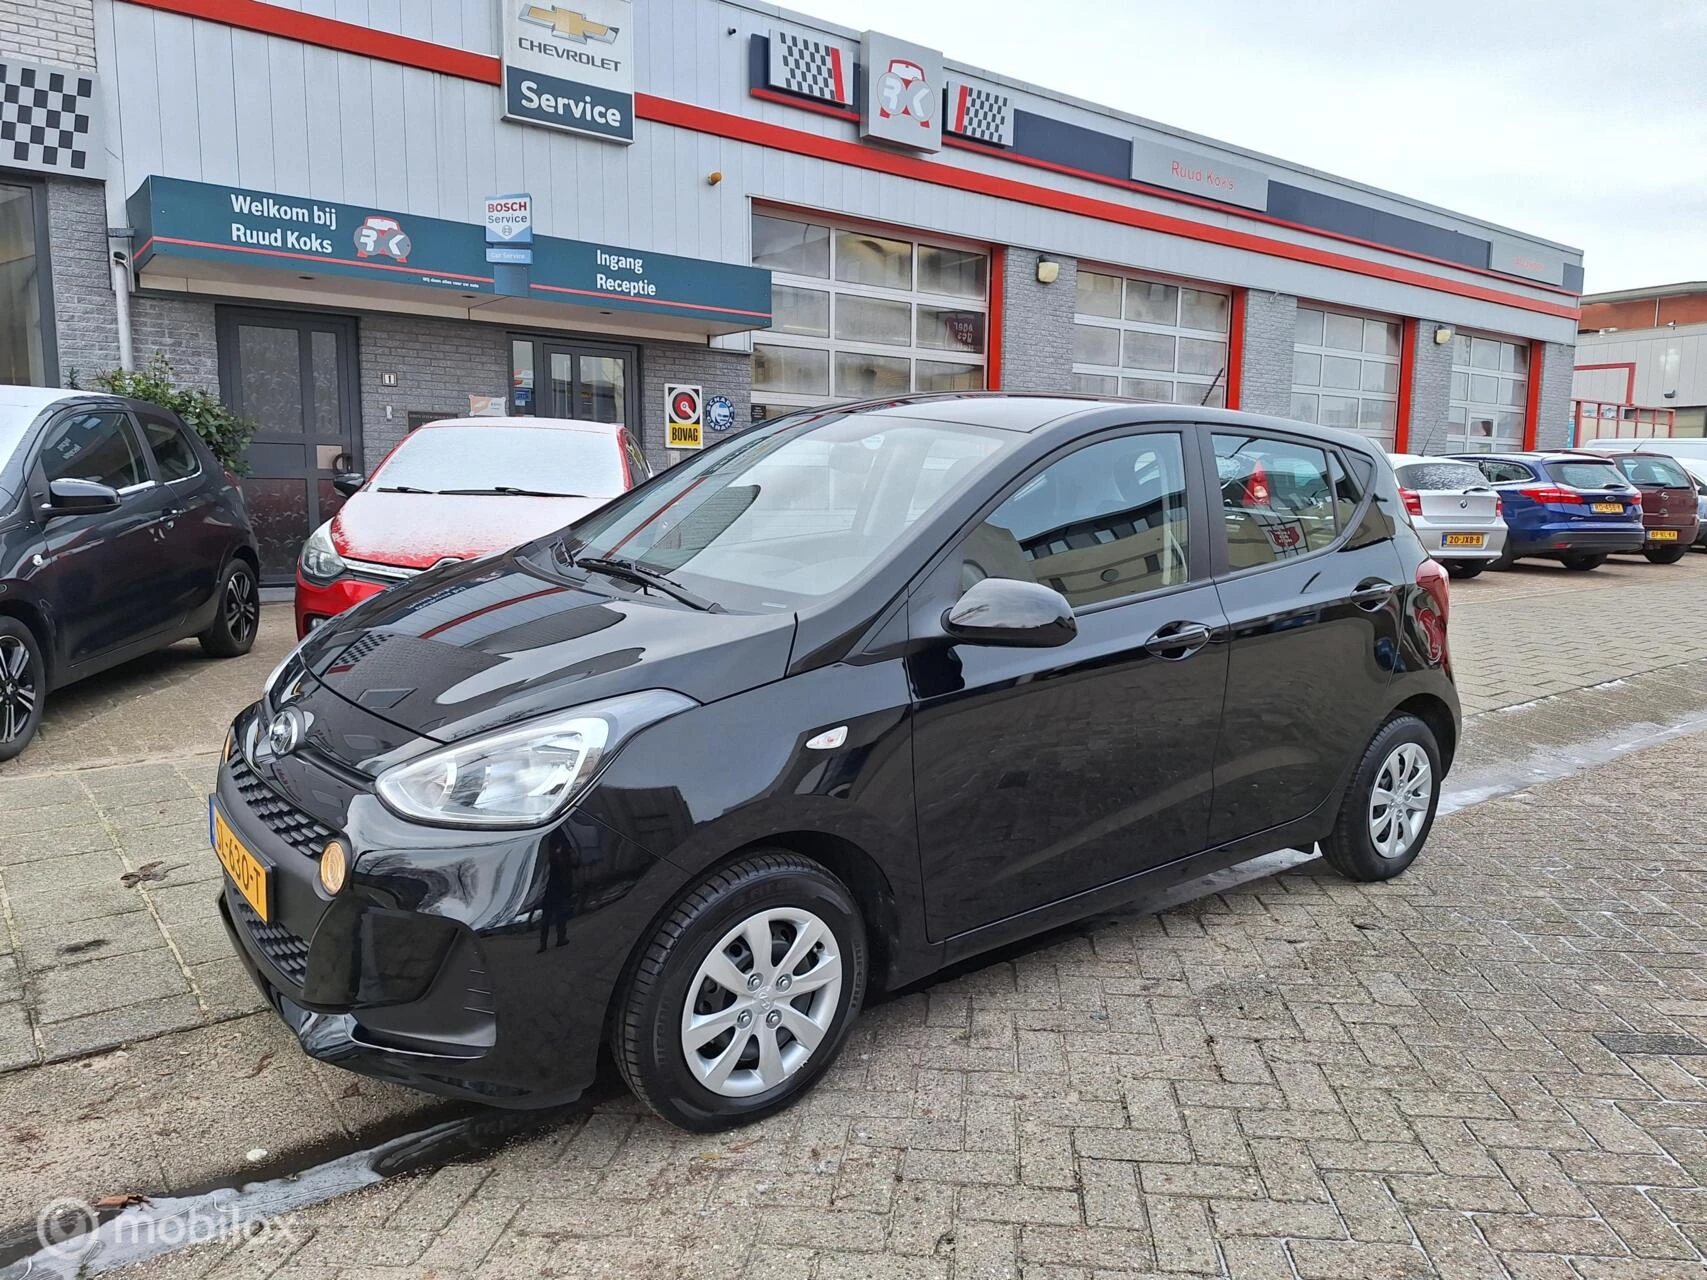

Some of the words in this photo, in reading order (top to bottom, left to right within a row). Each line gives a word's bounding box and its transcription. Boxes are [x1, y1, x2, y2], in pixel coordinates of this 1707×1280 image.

[518, 37, 621, 72] CHEVROLET
[520, 80, 621, 127] Service
[230, 194, 309, 223] Welkom
[313, 205, 337, 231] bij
[487, 201, 527, 213] BOSCH
[487, 214, 528, 224] Service
[231, 223, 281, 248] Ruud
[287, 231, 332, 254] Koks
[596, 249, 643, 274] Ingang
[596, 273, 656, 297] Receptie
[672, 427, 698, 442] BOVAG
